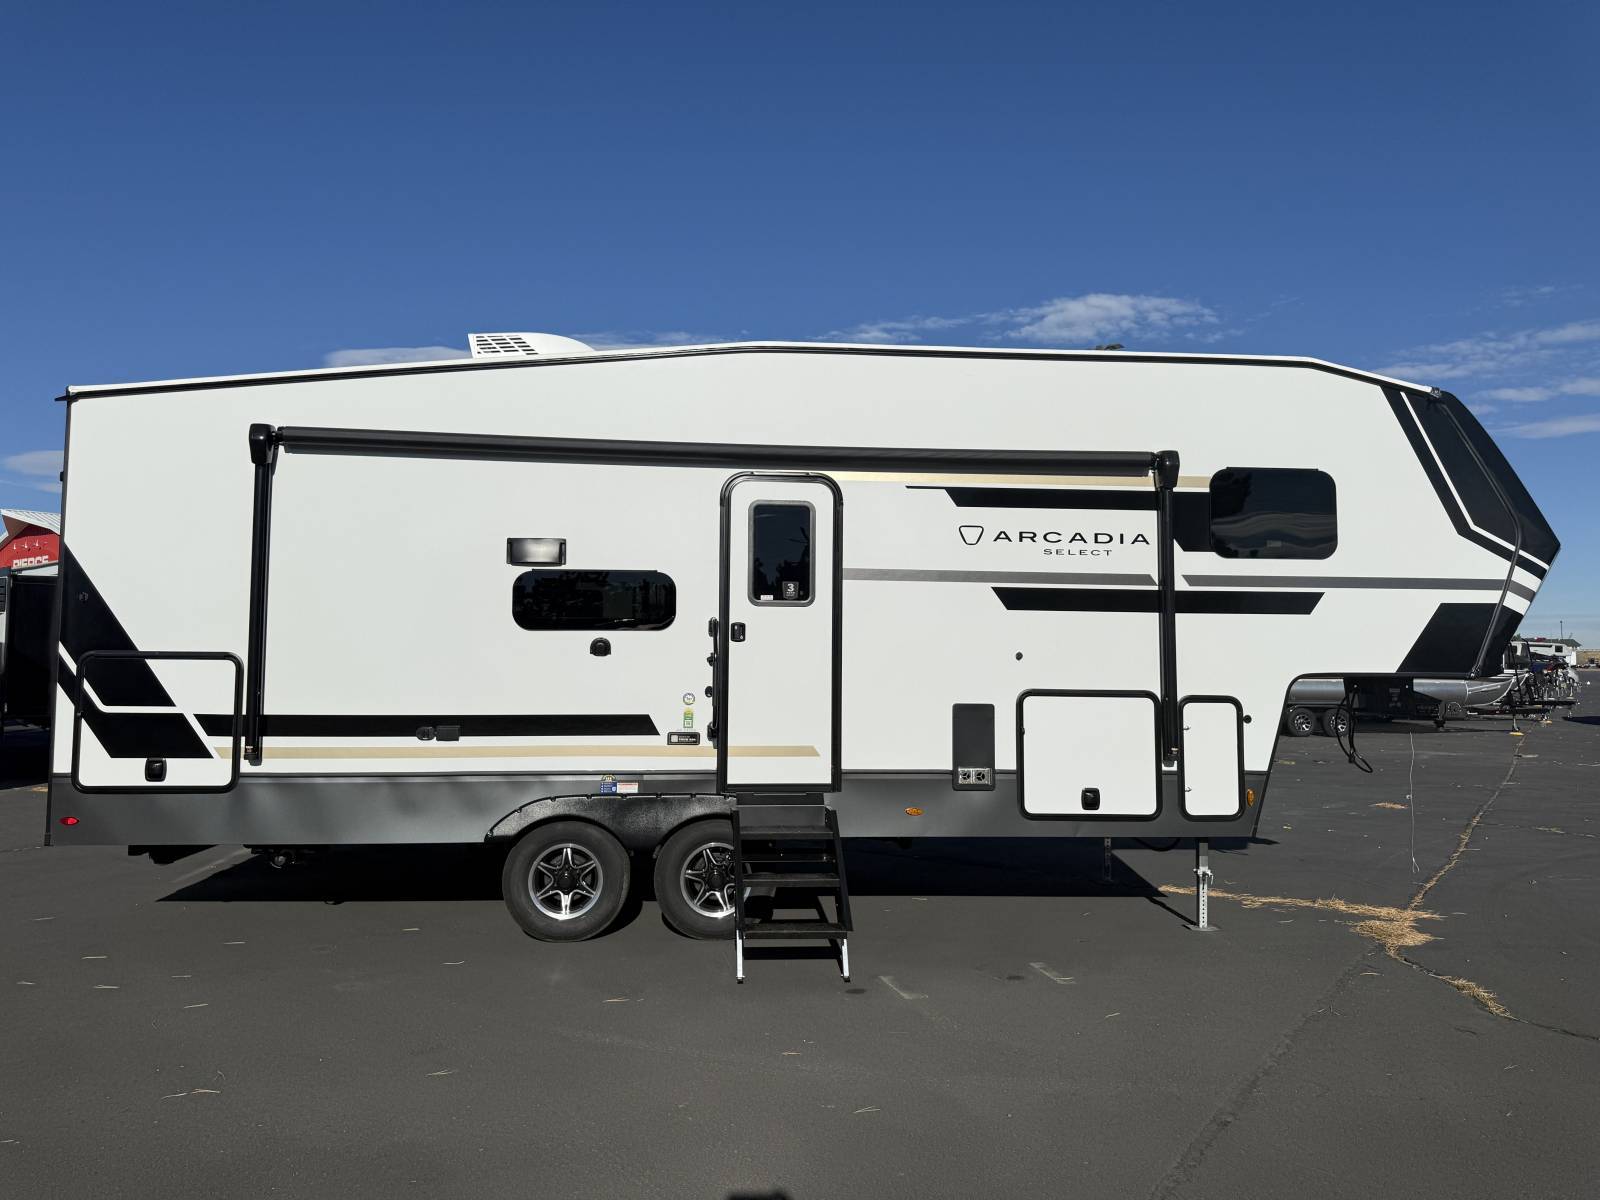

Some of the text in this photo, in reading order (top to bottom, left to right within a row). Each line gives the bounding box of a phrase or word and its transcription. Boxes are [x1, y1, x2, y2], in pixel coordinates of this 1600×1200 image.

[992, 530, 1151, 546] ARCADIA
[1042, 548, 1113, 557] SELECT
[787, 583, 795, 592] 3
